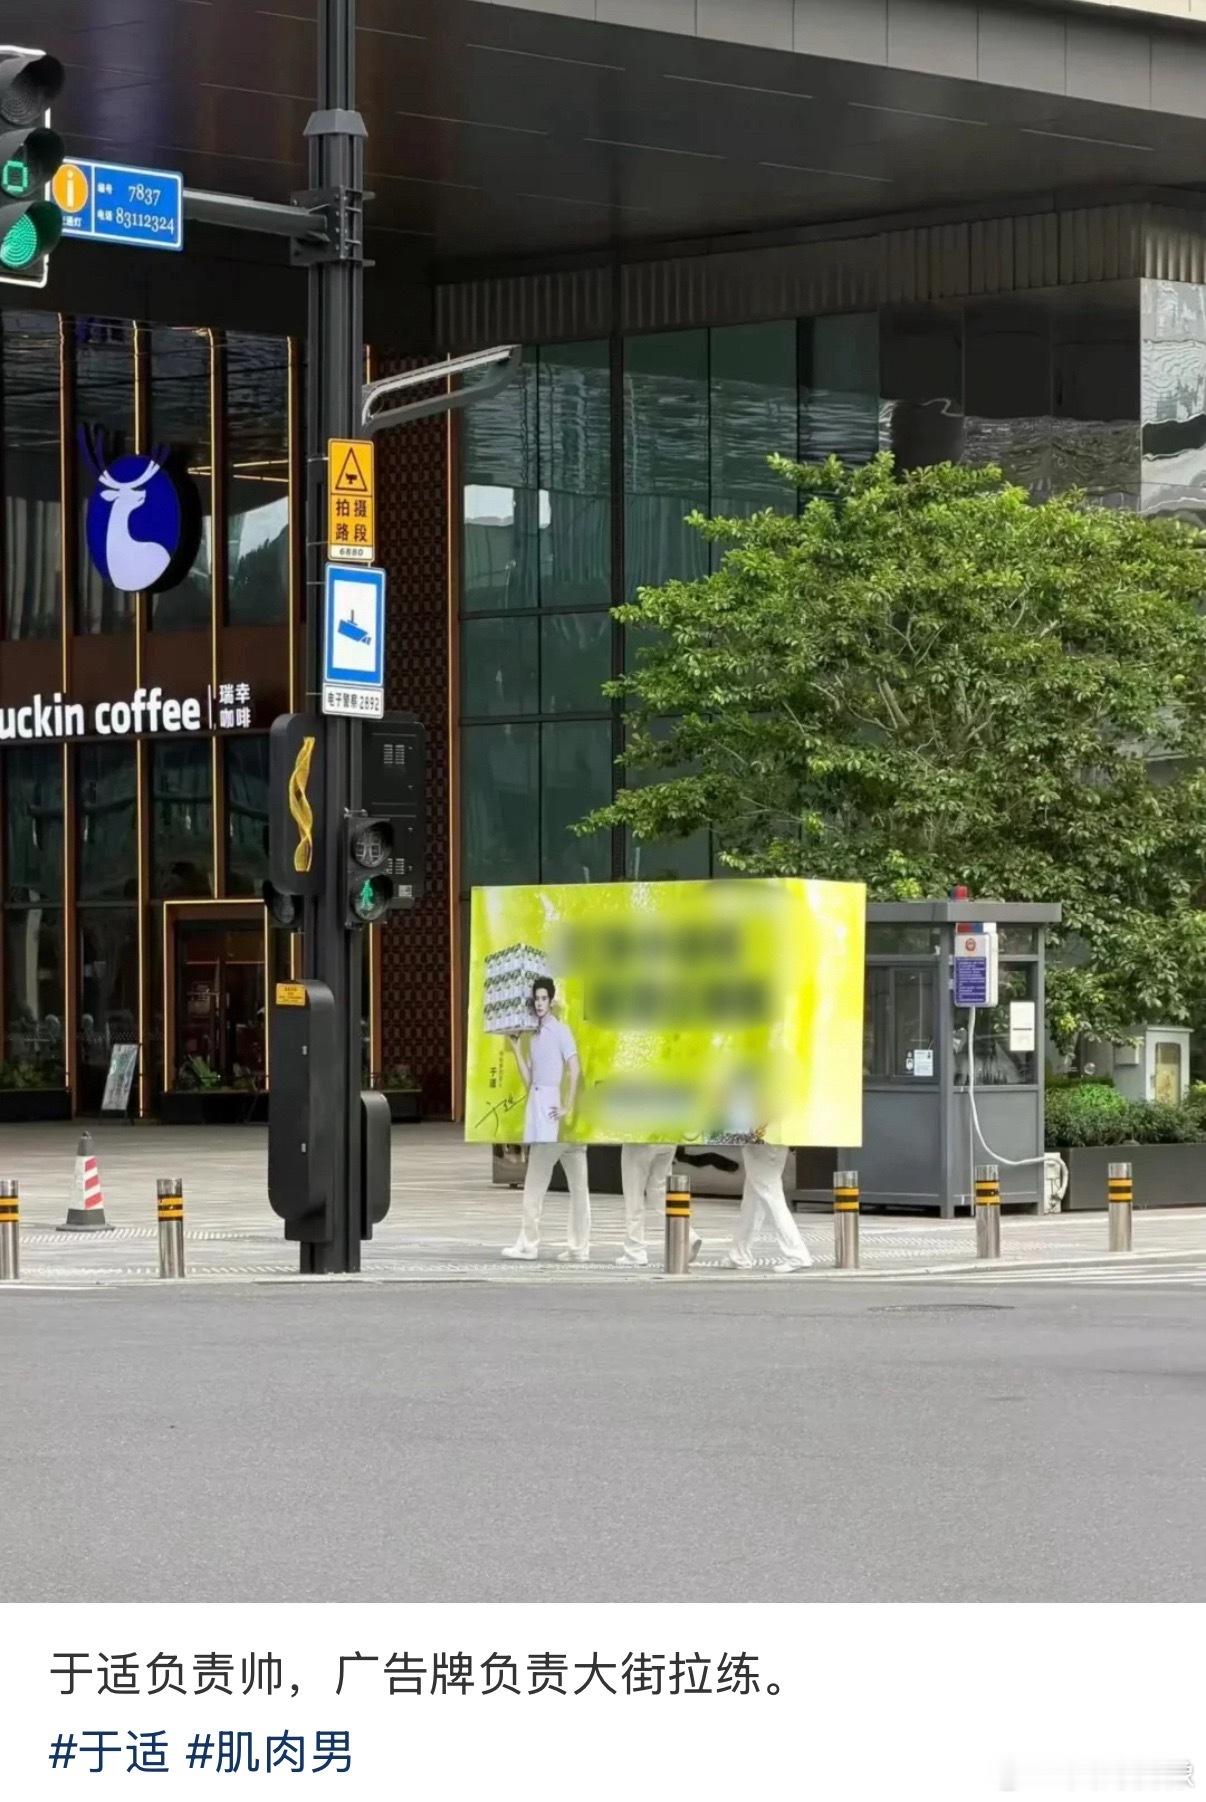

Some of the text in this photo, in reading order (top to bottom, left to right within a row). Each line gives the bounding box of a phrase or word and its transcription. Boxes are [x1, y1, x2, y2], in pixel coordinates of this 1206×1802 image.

[128, 184, 161, 206] 7837
[115, 207, 175, 235] 83112324
[336, 498, 368, 519] 拍摄
[336, 523, 368, 542] 路段
[219, 682, 251, 704] 瑞幸
[0, 687, 201, 740] uckin coffee
[219, 706, 251, 729] 咖啡
